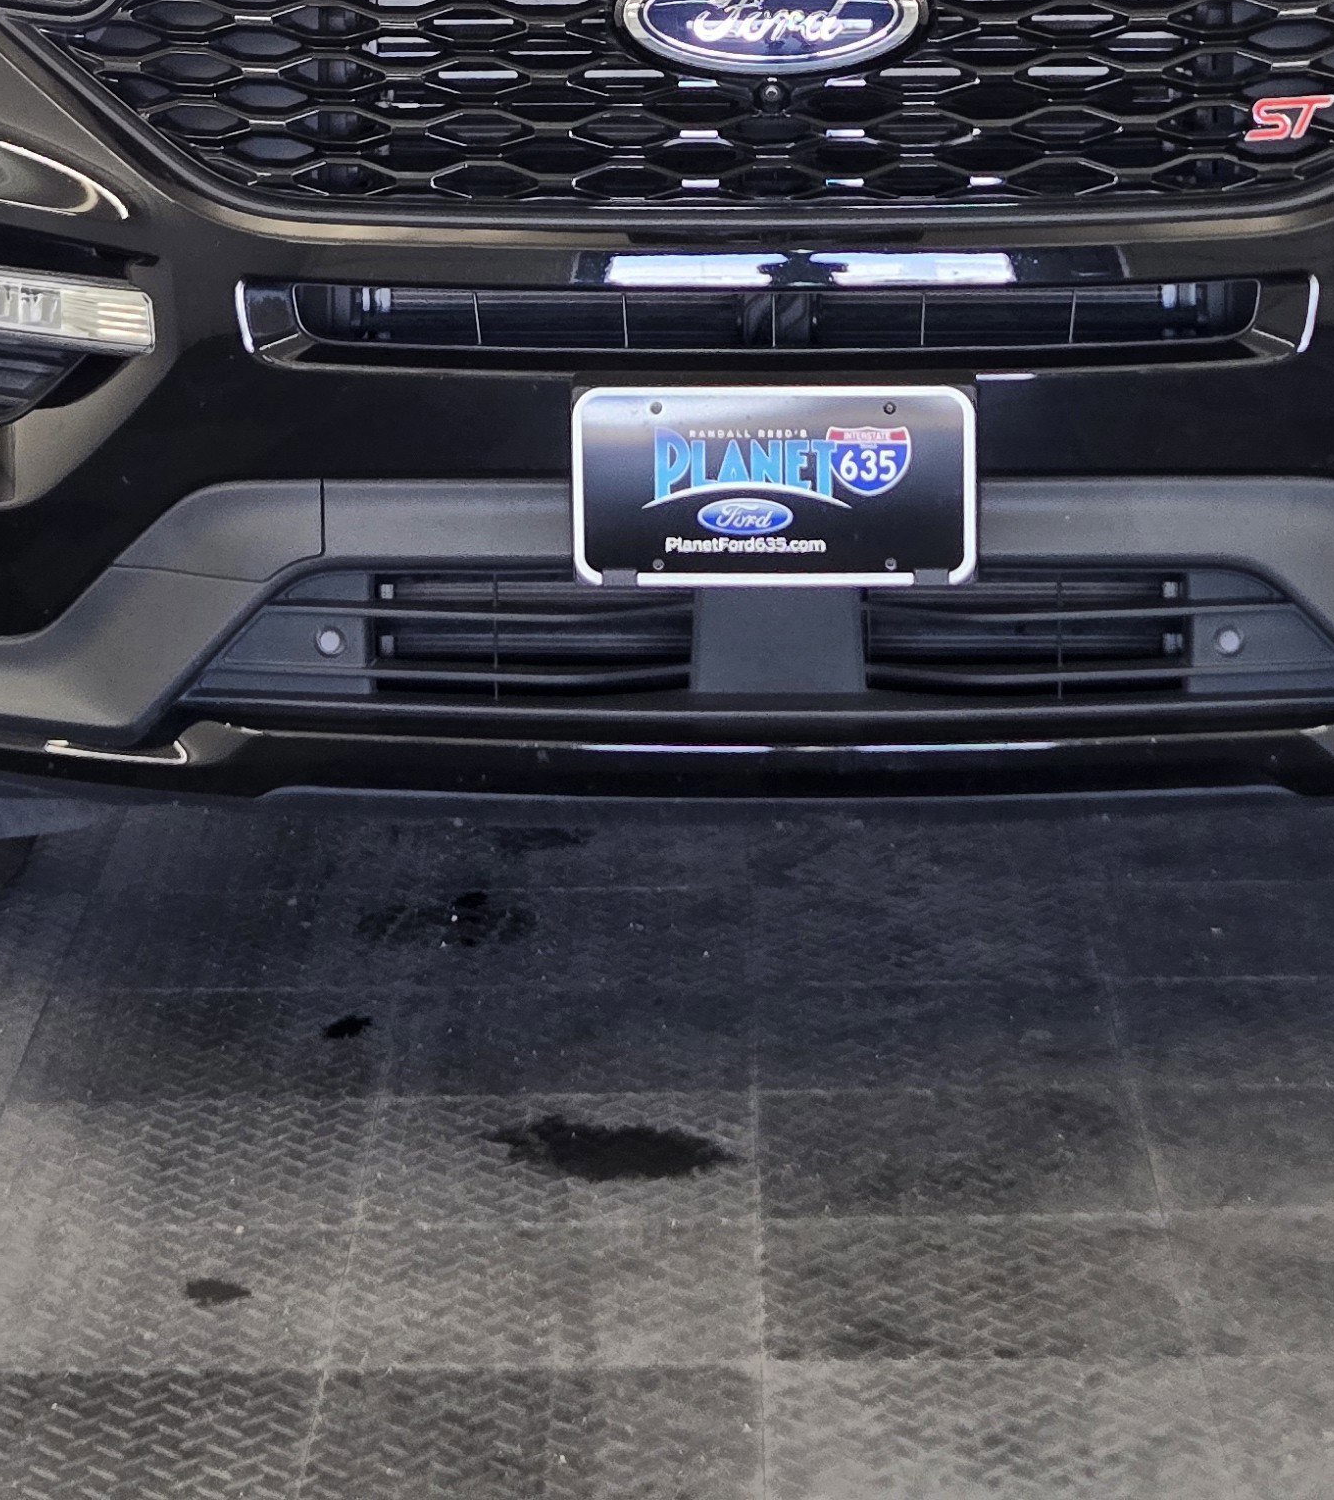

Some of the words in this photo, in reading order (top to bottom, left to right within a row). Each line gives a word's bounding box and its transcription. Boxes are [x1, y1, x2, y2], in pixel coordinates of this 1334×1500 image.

[654, 427, 837, 500] PLANET
[840, 449, 897, 481] 635
[715, 503, 773, 528] Ford
[665, 536, 827, 553] PlanetFord635.com
